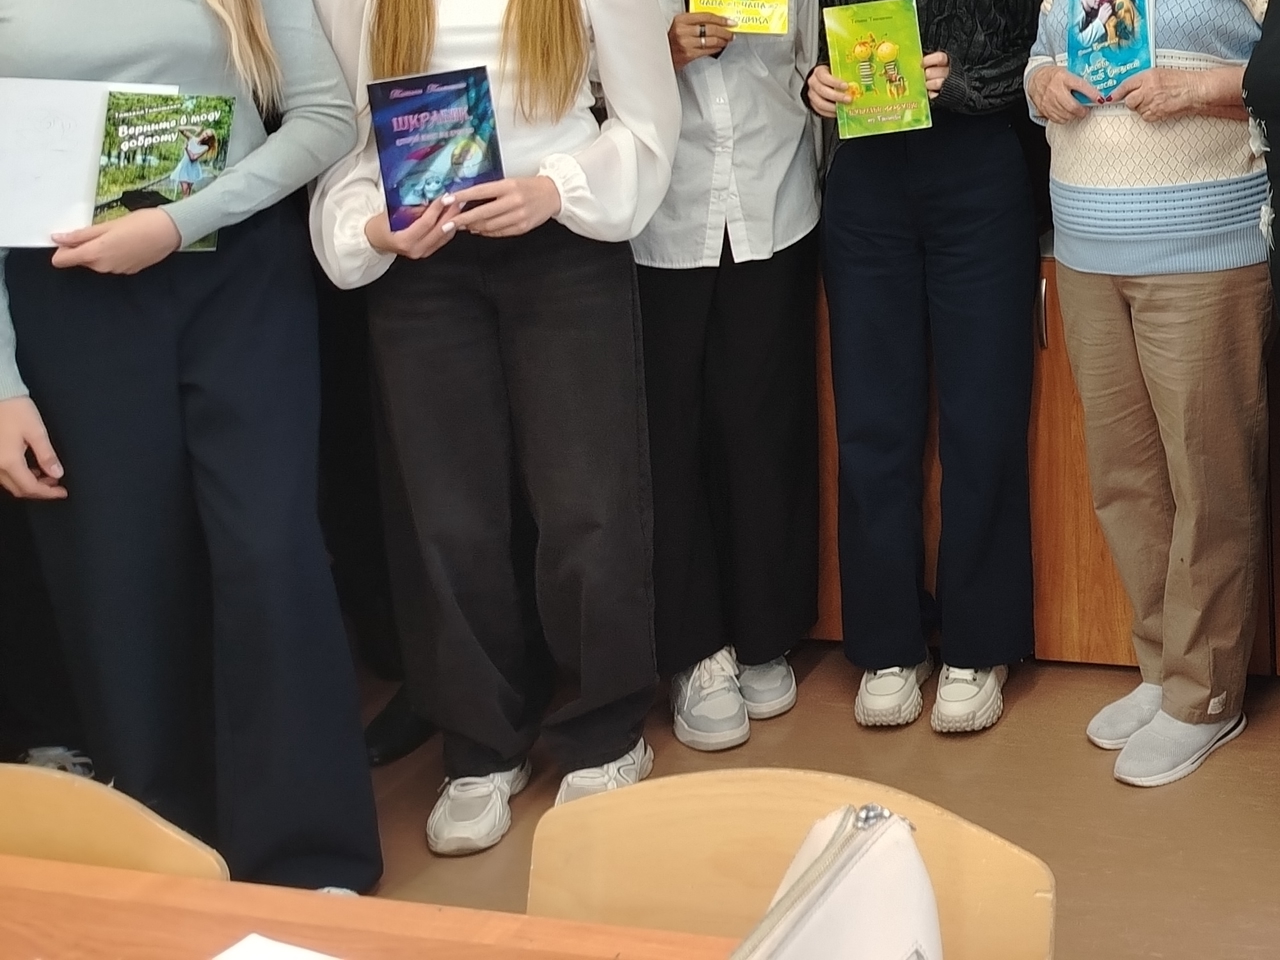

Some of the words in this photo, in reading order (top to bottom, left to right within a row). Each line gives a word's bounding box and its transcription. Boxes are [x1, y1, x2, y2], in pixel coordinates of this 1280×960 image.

[118, 119, 177, 137] Верните
[180, 115, 188, 125] в
[190, 110, 222, 124] моду
[120, 131, 179, 152] доброту
